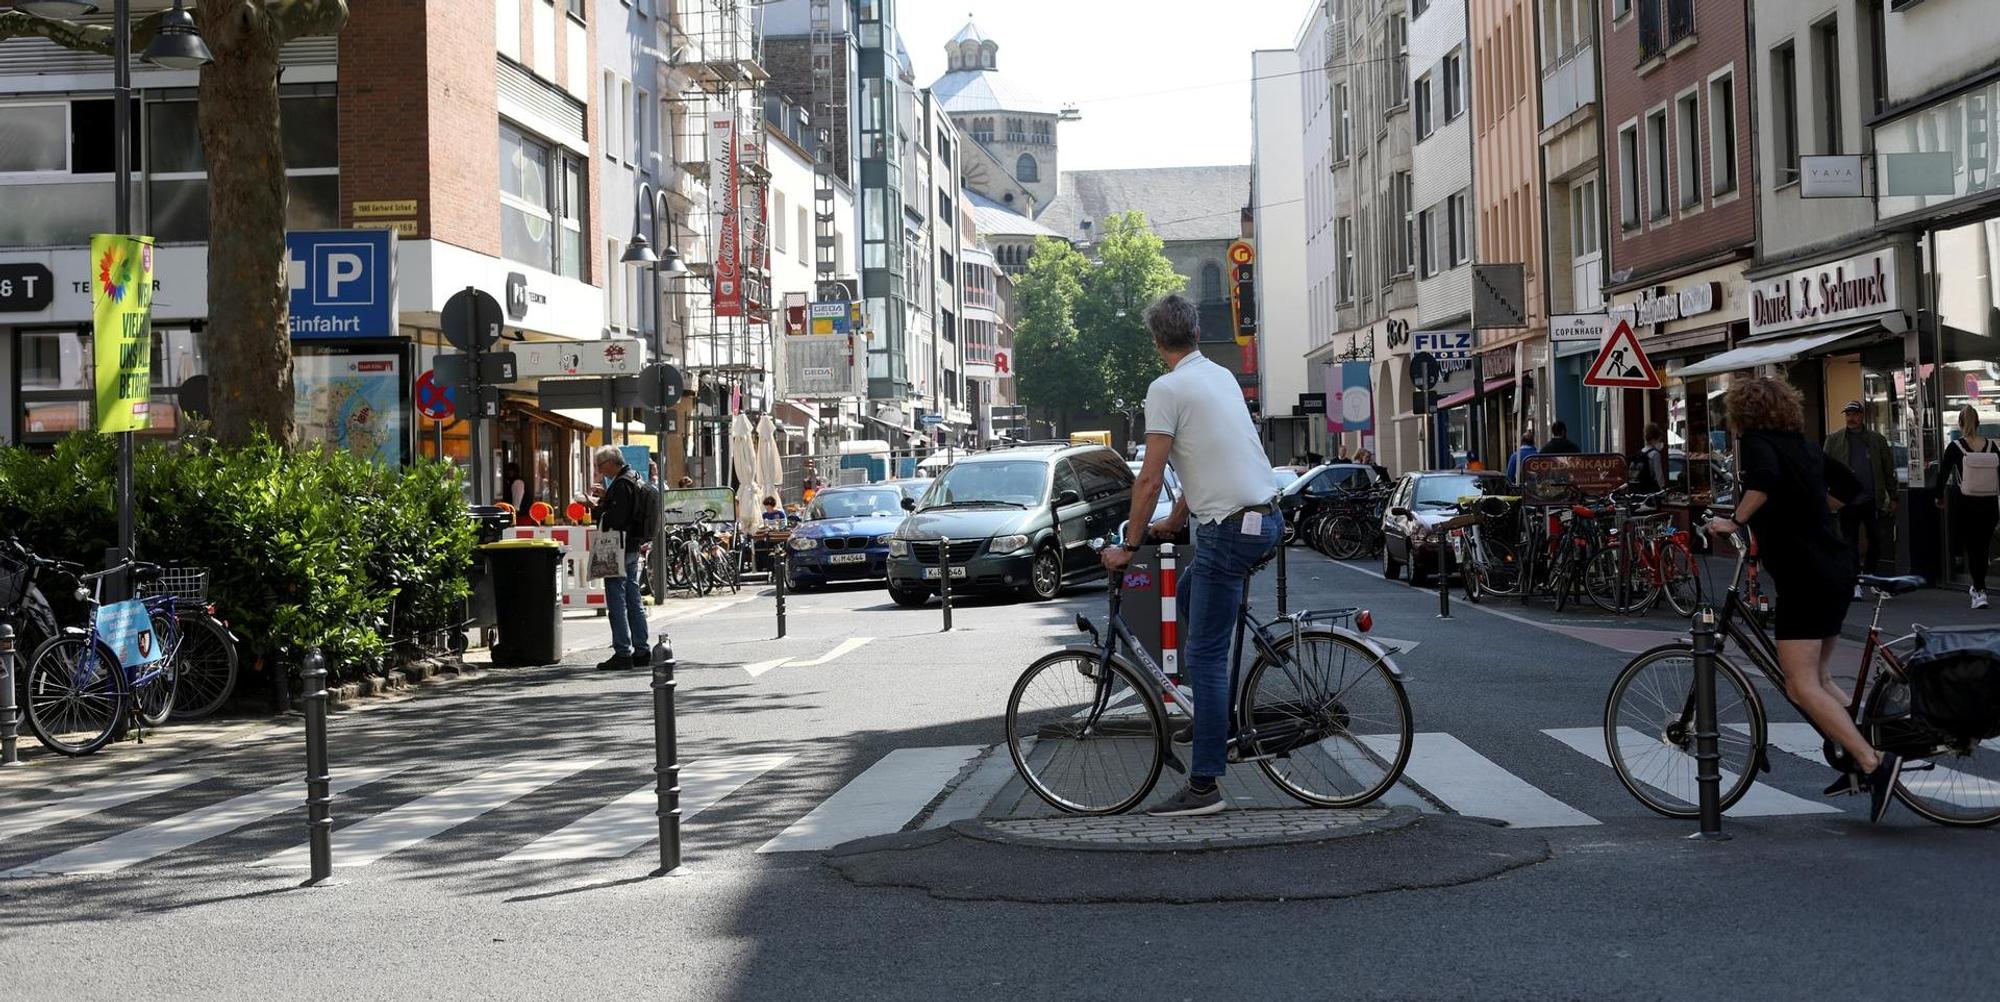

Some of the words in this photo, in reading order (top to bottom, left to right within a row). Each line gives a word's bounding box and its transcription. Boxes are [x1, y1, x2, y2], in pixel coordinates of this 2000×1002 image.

[1811, 168, 1852, 176] YAYA
[328, 253, 363, 298] P
[22, 276, 39, 298] T
[289, 315, 360, 332] Einfahrt
[1415, 333, 1471, 350] FILZ
